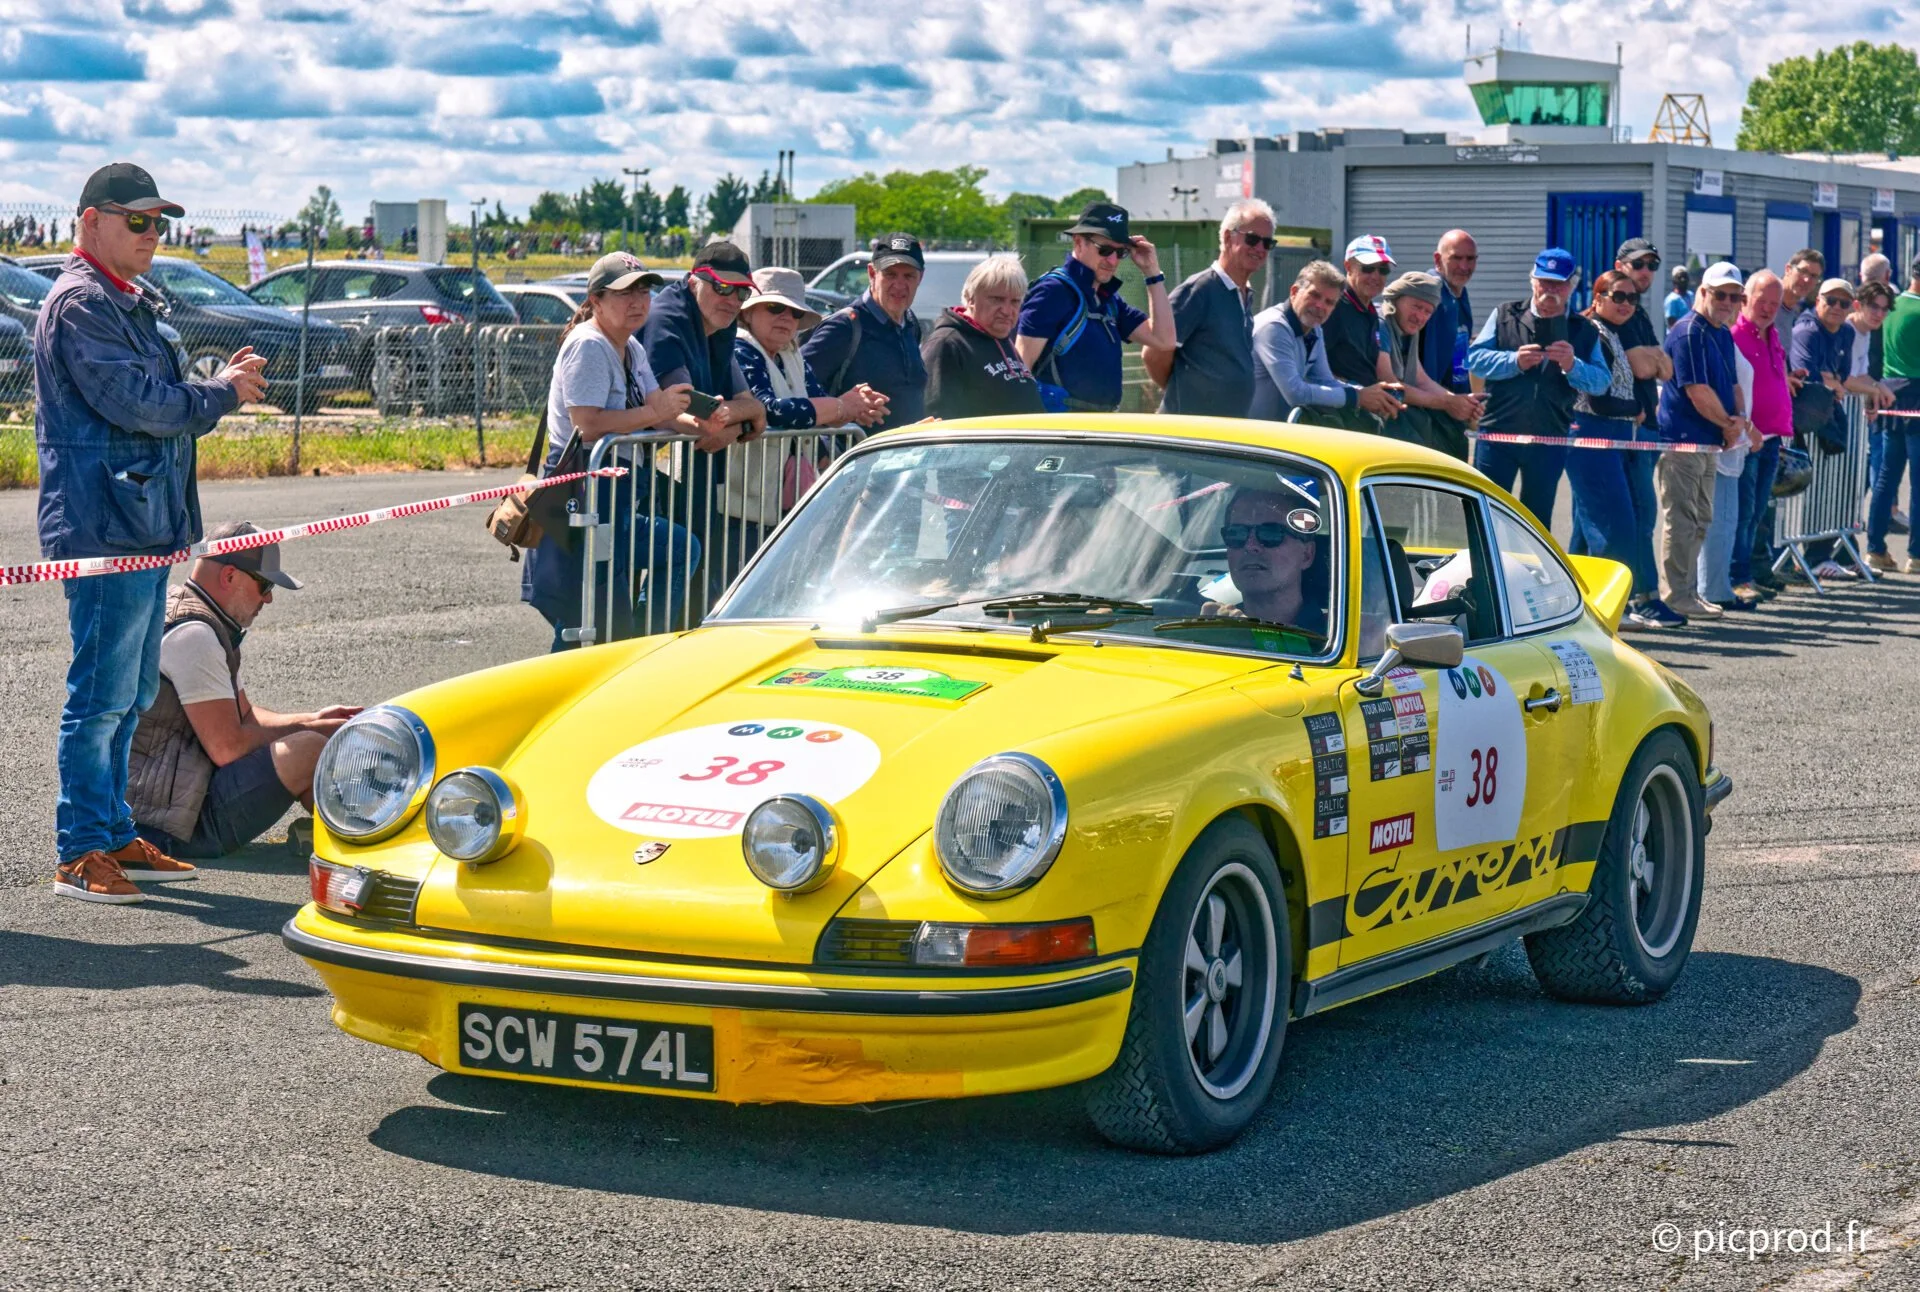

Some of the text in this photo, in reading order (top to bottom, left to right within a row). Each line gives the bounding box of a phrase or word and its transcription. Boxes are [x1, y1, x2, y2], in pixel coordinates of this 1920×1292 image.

[984, 359, 1008, 376] Los
[866, 671, 905, 681] 38
[1362, 700, 1392, 715] TOUR AUTO
[1394, 695, 1424, 714] MOTUL
[1371, 740, 1399, 756] TOUR AUTO
[678, 756, 785, 786] 38
[1466, 746, 1498, 808] 38
[1318, 797, 1345, 813] BALTIC
[626, 805, 735, 827] MOTUL
[1371, 818, 1413, 849] MOTUL
[1346, 833, 1563, 936] Carrera
[463, 1012, 709, 1084] SCW 574L
